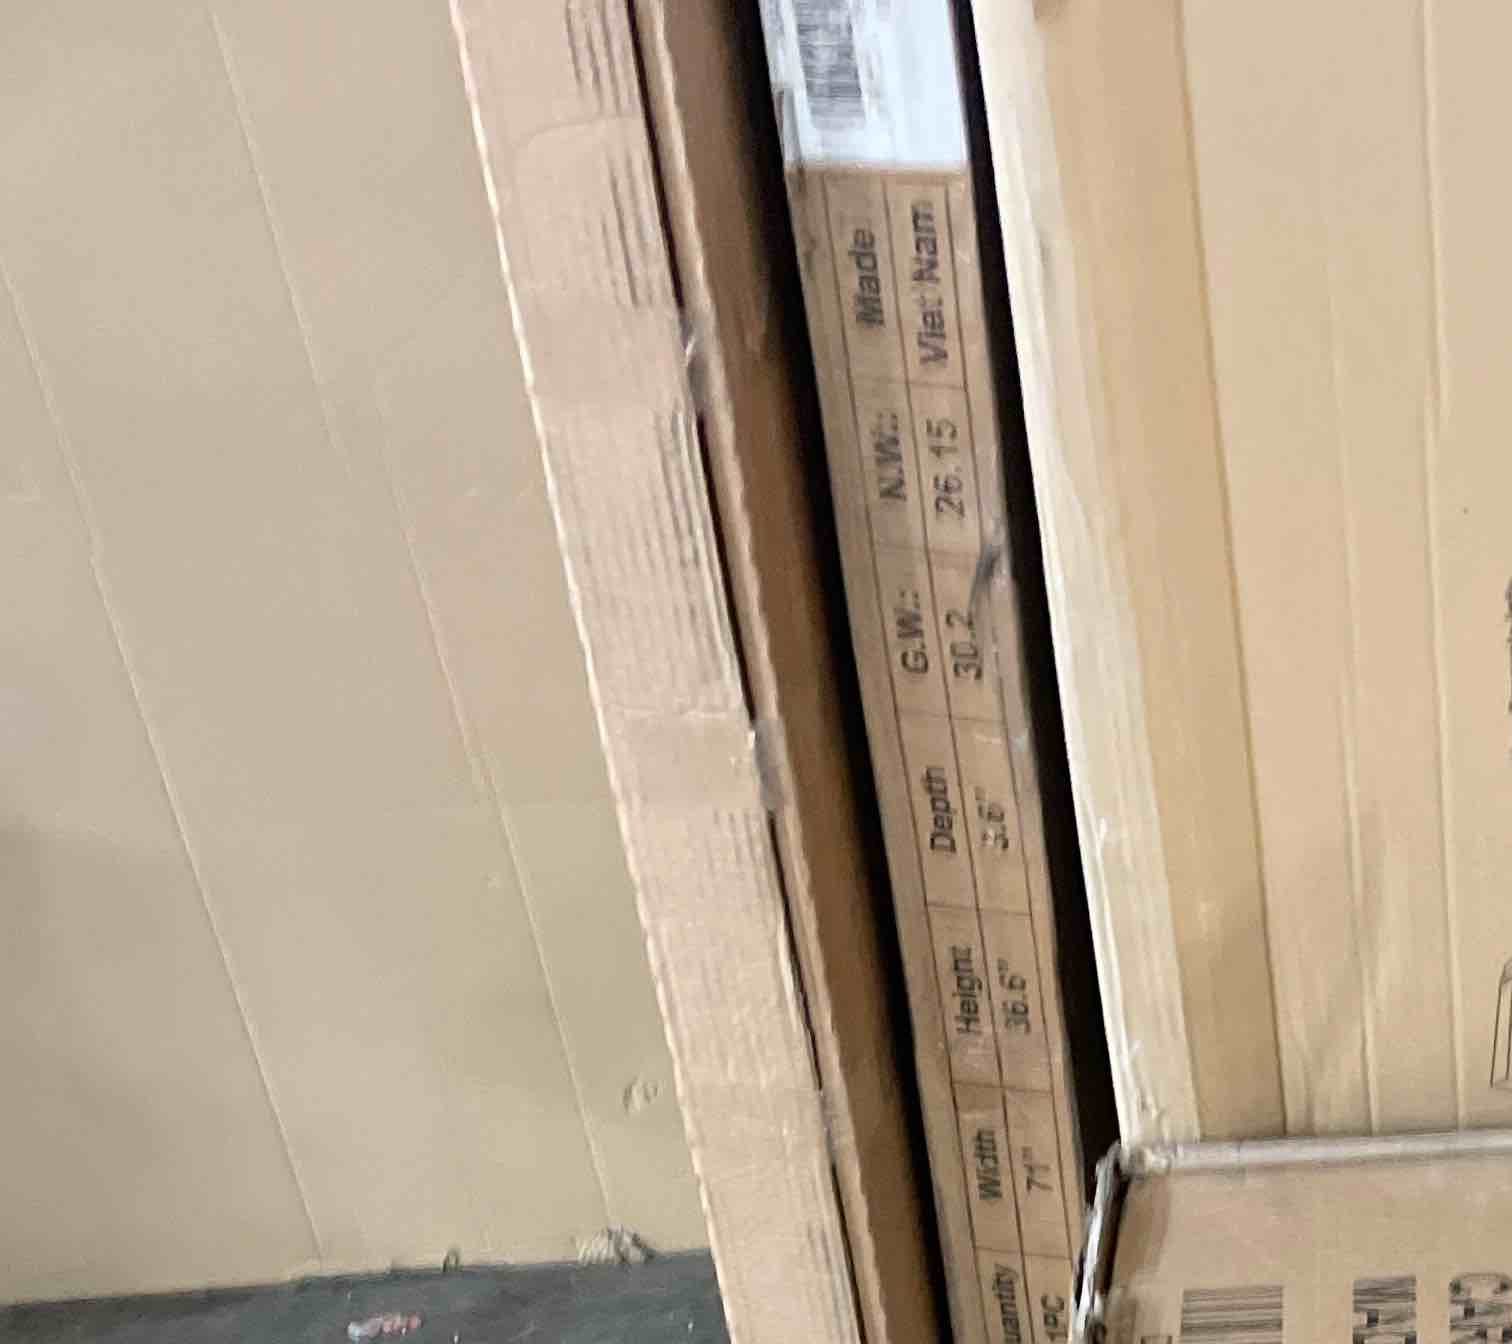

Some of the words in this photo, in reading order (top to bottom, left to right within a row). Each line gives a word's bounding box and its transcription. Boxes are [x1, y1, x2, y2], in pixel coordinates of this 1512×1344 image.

[849, 228, 885, 329] Made
[911, 199, 941, 285] Nam
[926, 418, 965, 521] 26.15
[946, 606, 983, 681] 30.2
[922, 764, 957, 855] Depth
[951, 944, 983, 1036] Height
[973, 1128, 1003, 1203] Width
